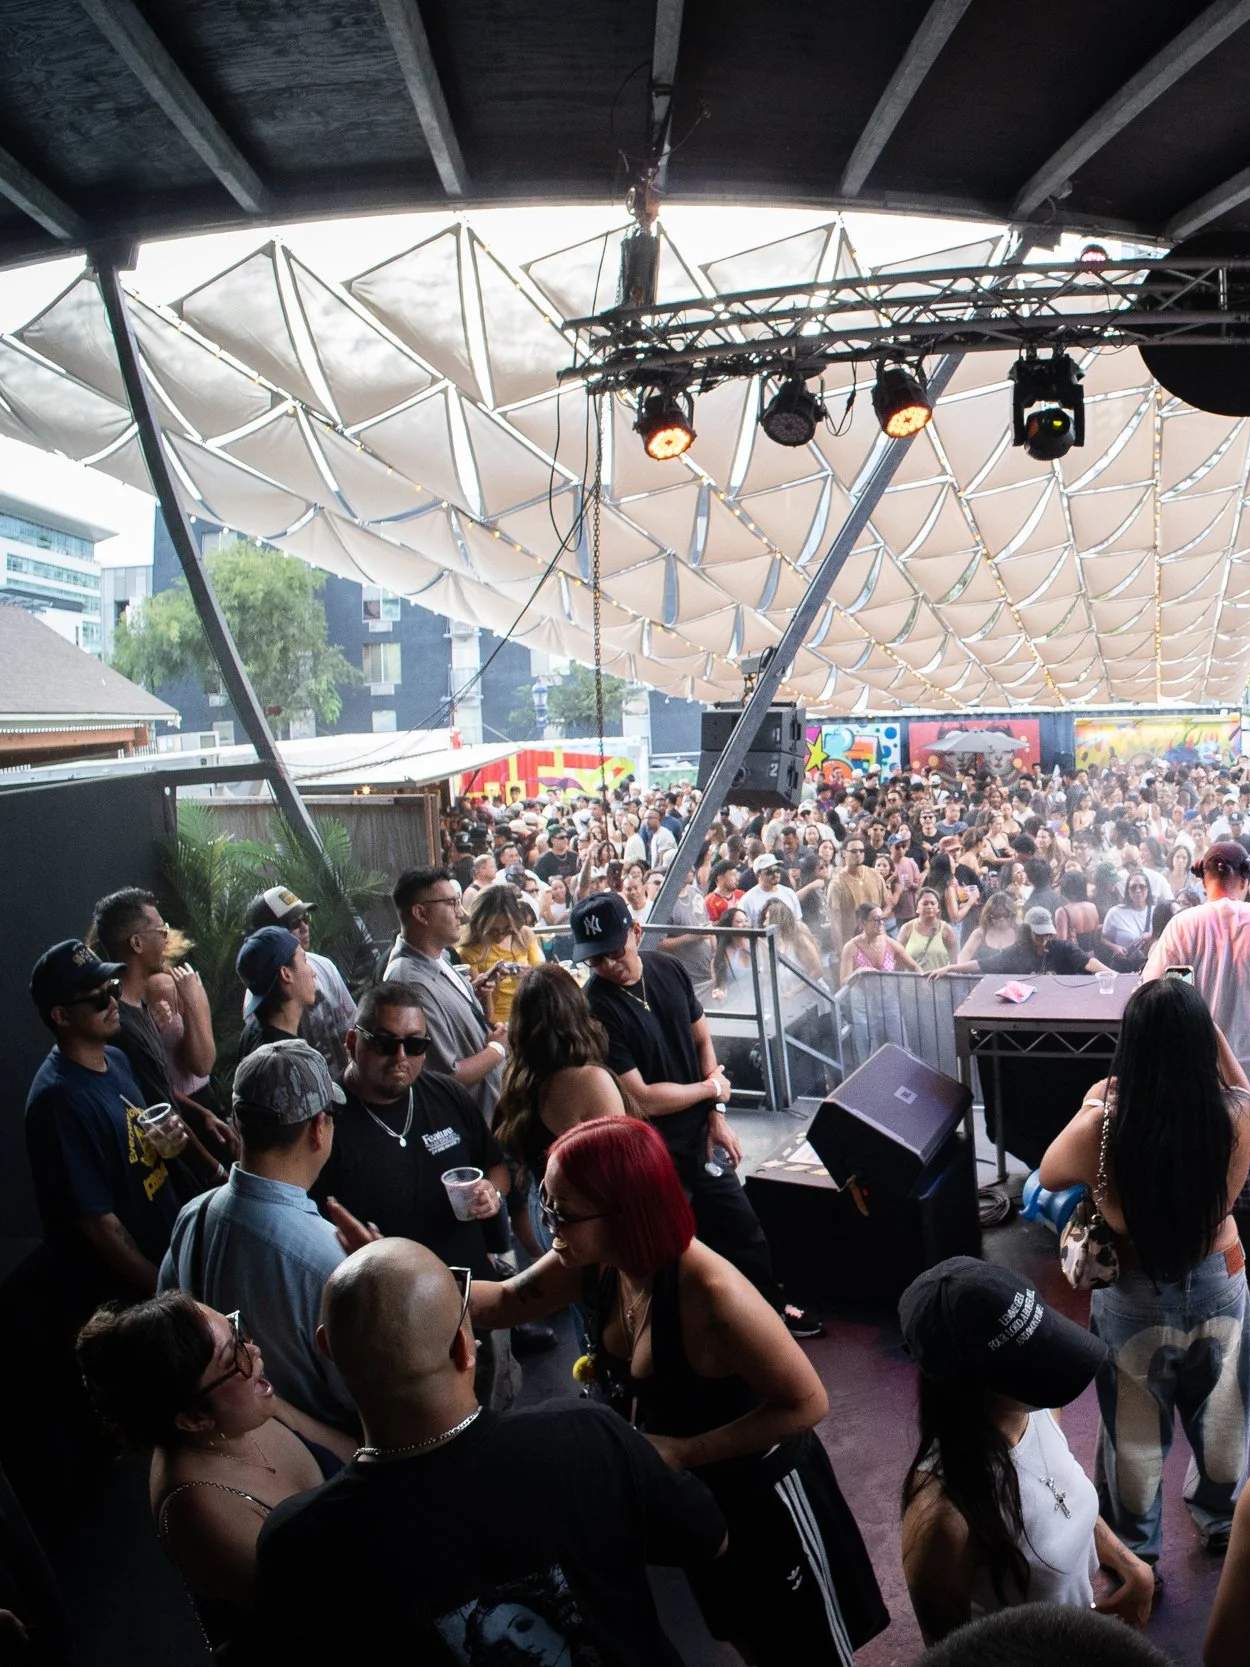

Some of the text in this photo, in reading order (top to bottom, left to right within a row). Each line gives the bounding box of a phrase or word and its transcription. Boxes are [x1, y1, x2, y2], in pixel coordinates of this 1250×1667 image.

[772, 727, 780, 743] 1
[769, 762, 779, 777] 2
[583, 914, 602, 936] NY
[421, 1127, 454, 1146] Feature
